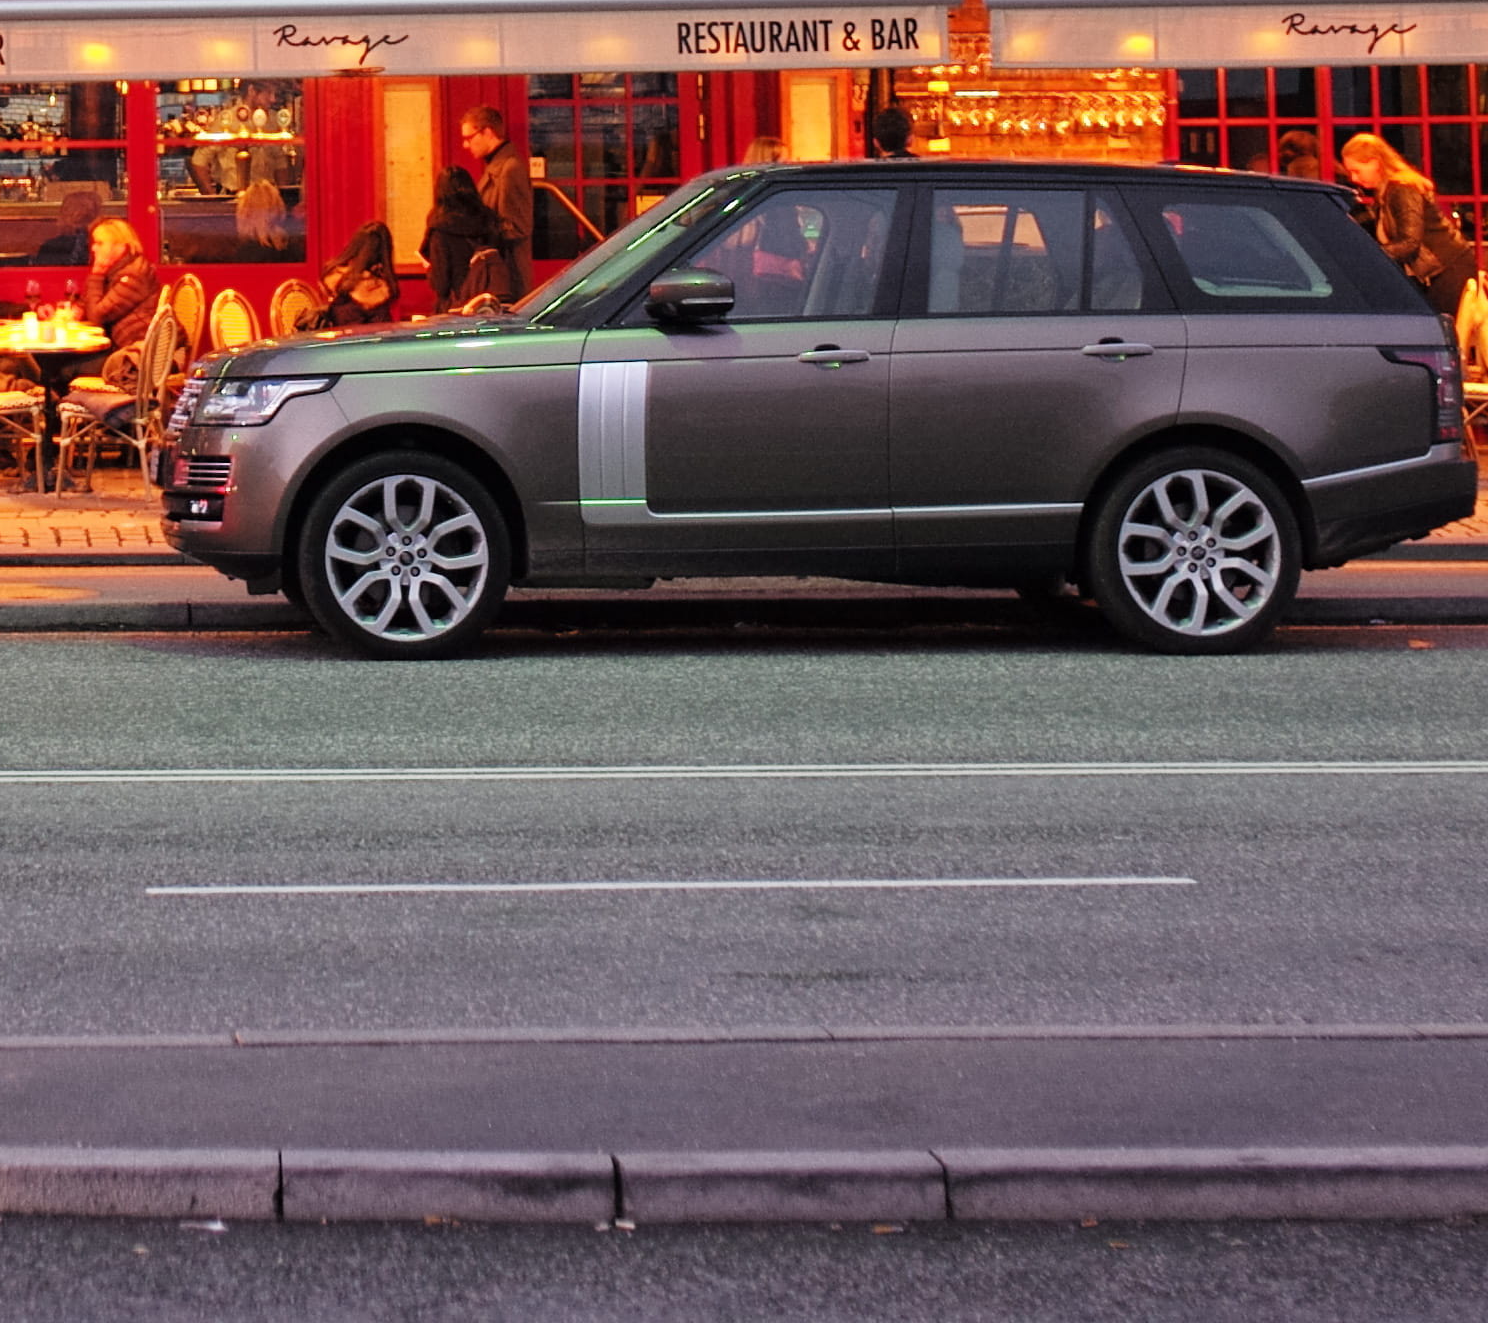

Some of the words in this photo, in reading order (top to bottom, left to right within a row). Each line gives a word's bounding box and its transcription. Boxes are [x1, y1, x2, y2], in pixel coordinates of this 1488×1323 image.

[272, 24, 409, 66] Ravage
[677, 19, 833, 55] RESTAURANT
[842, 21, 860, 52] &
[870, 17, 919, 51] BAR
[1281, 12, 1417, 55] Ravage
